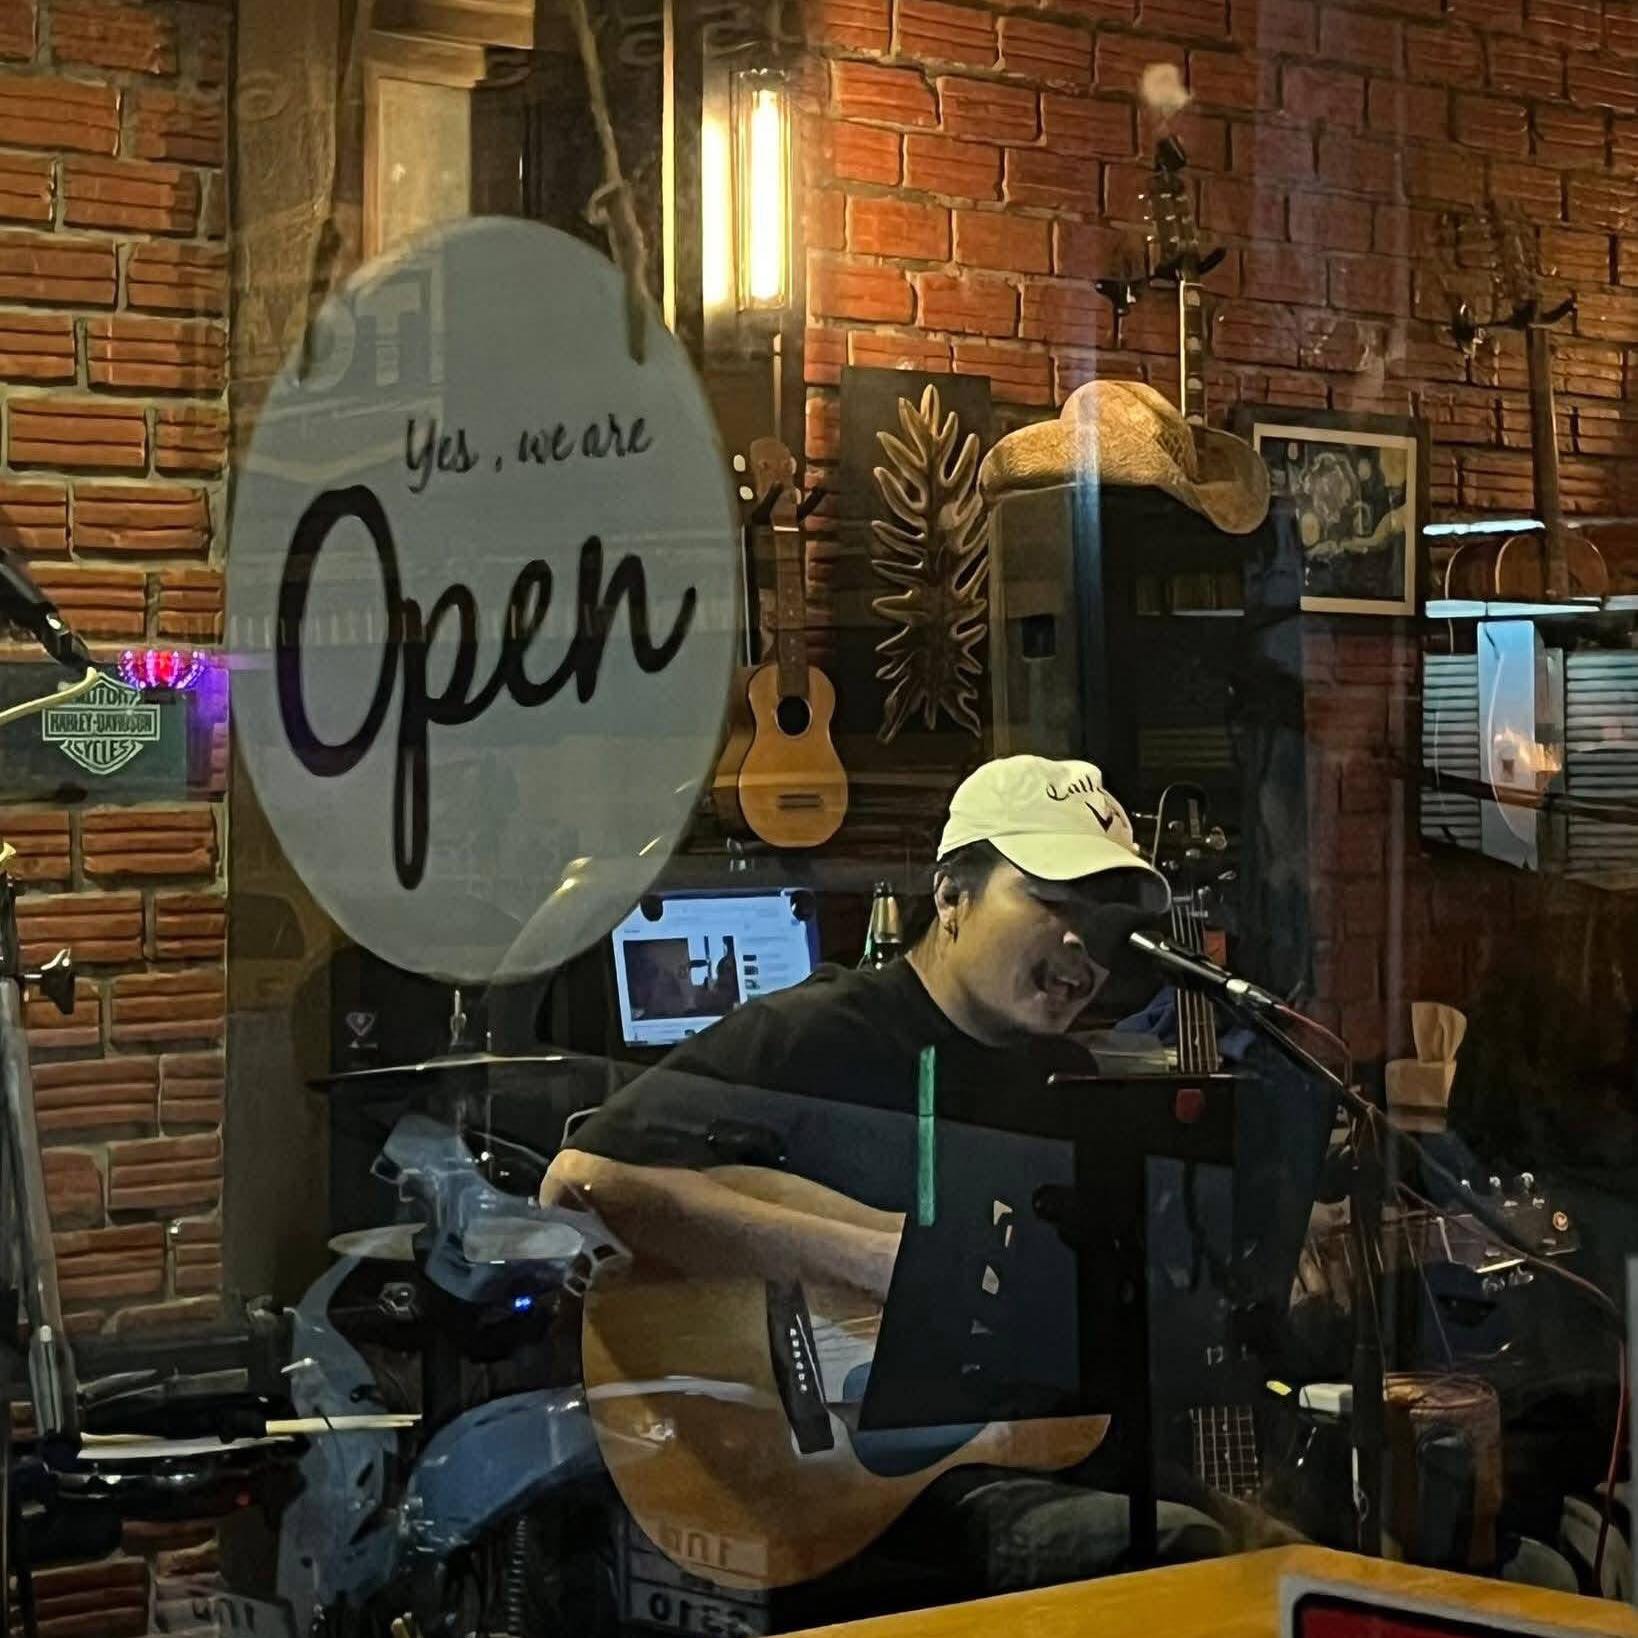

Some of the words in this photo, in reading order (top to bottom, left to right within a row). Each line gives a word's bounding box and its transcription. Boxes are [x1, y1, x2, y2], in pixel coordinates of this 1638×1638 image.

[518, 422, 575, 464] we
[583, 412, 653, 458] are
[276, 484, 697, 891] Open
[50, 712, 153, 734] HARLEY-DAVIDSON
[72, 740, 134, 764] CYCLES
